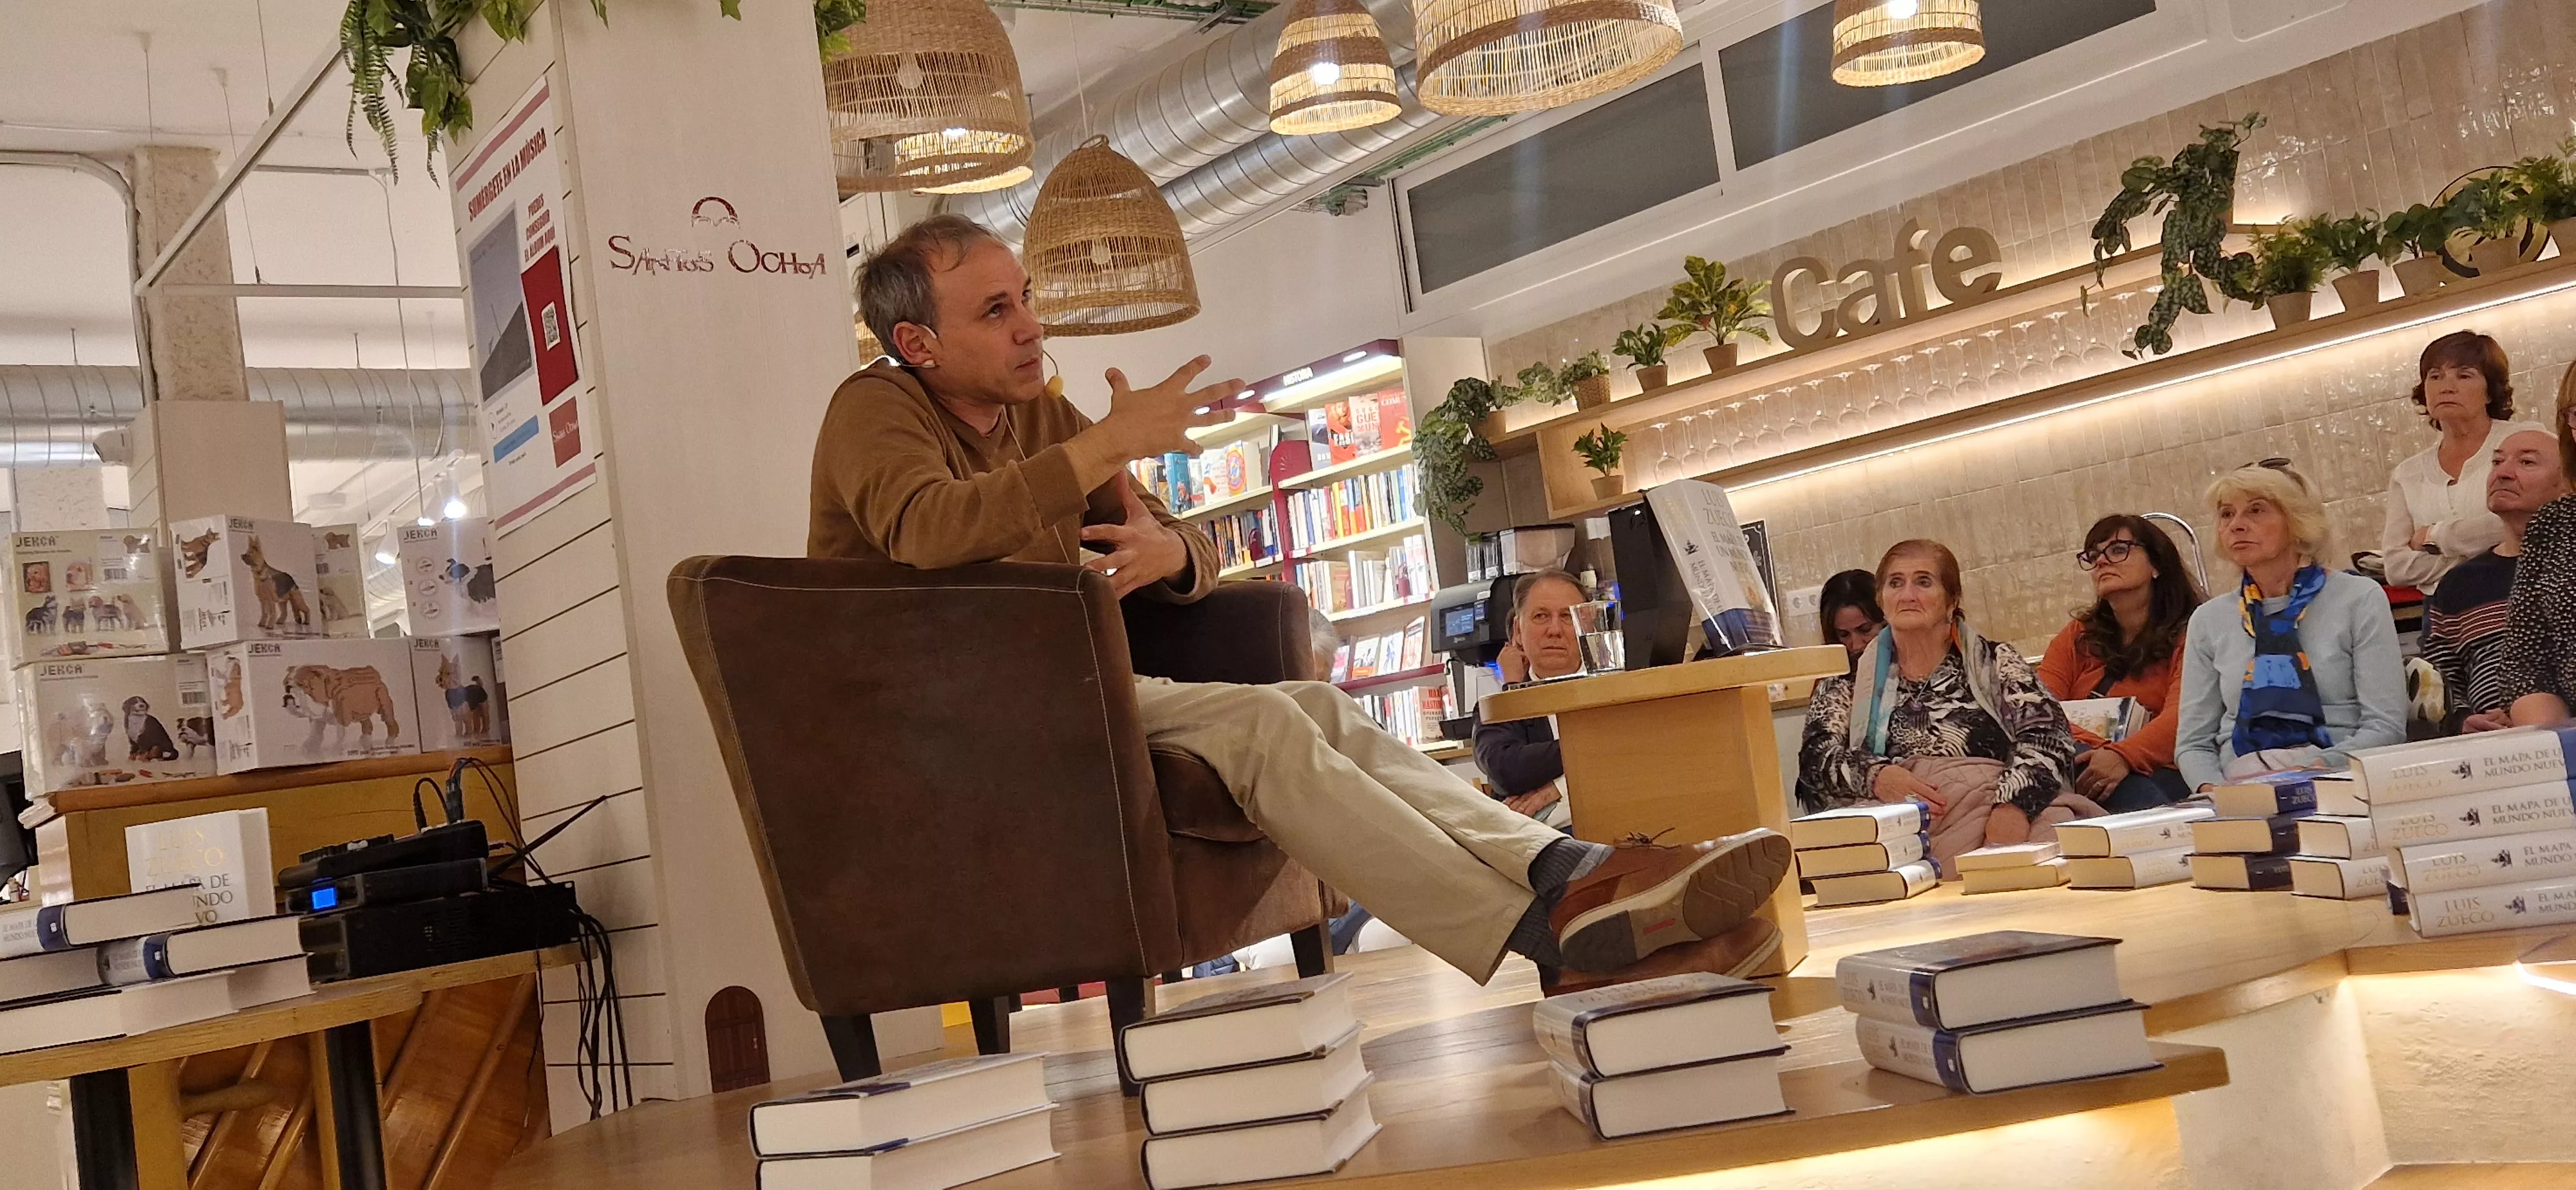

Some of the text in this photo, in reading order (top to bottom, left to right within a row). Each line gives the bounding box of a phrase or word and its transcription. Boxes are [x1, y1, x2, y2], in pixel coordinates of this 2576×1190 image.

[468, 171, 504, 222] SUMÉRGETE
[502, 162, 511, 188] EN
[511, 155, 520, 179] LA
[519, 127, 547, 171] MÚSICA
[1771, 217, 2003, 346] Cafe
[16, 535, 56, 547] JEKCA
[404, 529, 437, 540] JEKCA
[248, 643, 281, 654] JEKCA
[413, 639, 440, 648] JEKCA
[40, 664, 82, 675] JEKCA
[2483, 757, 2496, 767] EL
[2499, 752, 2532, 766] MAPA
[2535, 750, 2550, 760] DE
[2485, 764, 2531, 777] MUNDO
[2533, 759, 2566, 771] NUEV
[2492, 804, 2505, 814] EL
[2507, 800, 2541, 813] MAPA
[2544, 798, 2559, 808] DE
[2392, 824, 2448, 840] ZUECO
[2492, 811, 2540, 825] MUNDO
[2543, 807, 2576, 819] NUEV
[2432, 842, 2573, 867] LUIS EL MAPA
[2524, 854, 2572, 866] MUNDO
[210, 873, 231, 889] DE
[193, 891, 233, 906] NDO
[2444, 896, 2481, 912] LUIS
[2538, 893, 2548, 902] EL
[2436, 902, 2576, 928] ZUECO MUND
